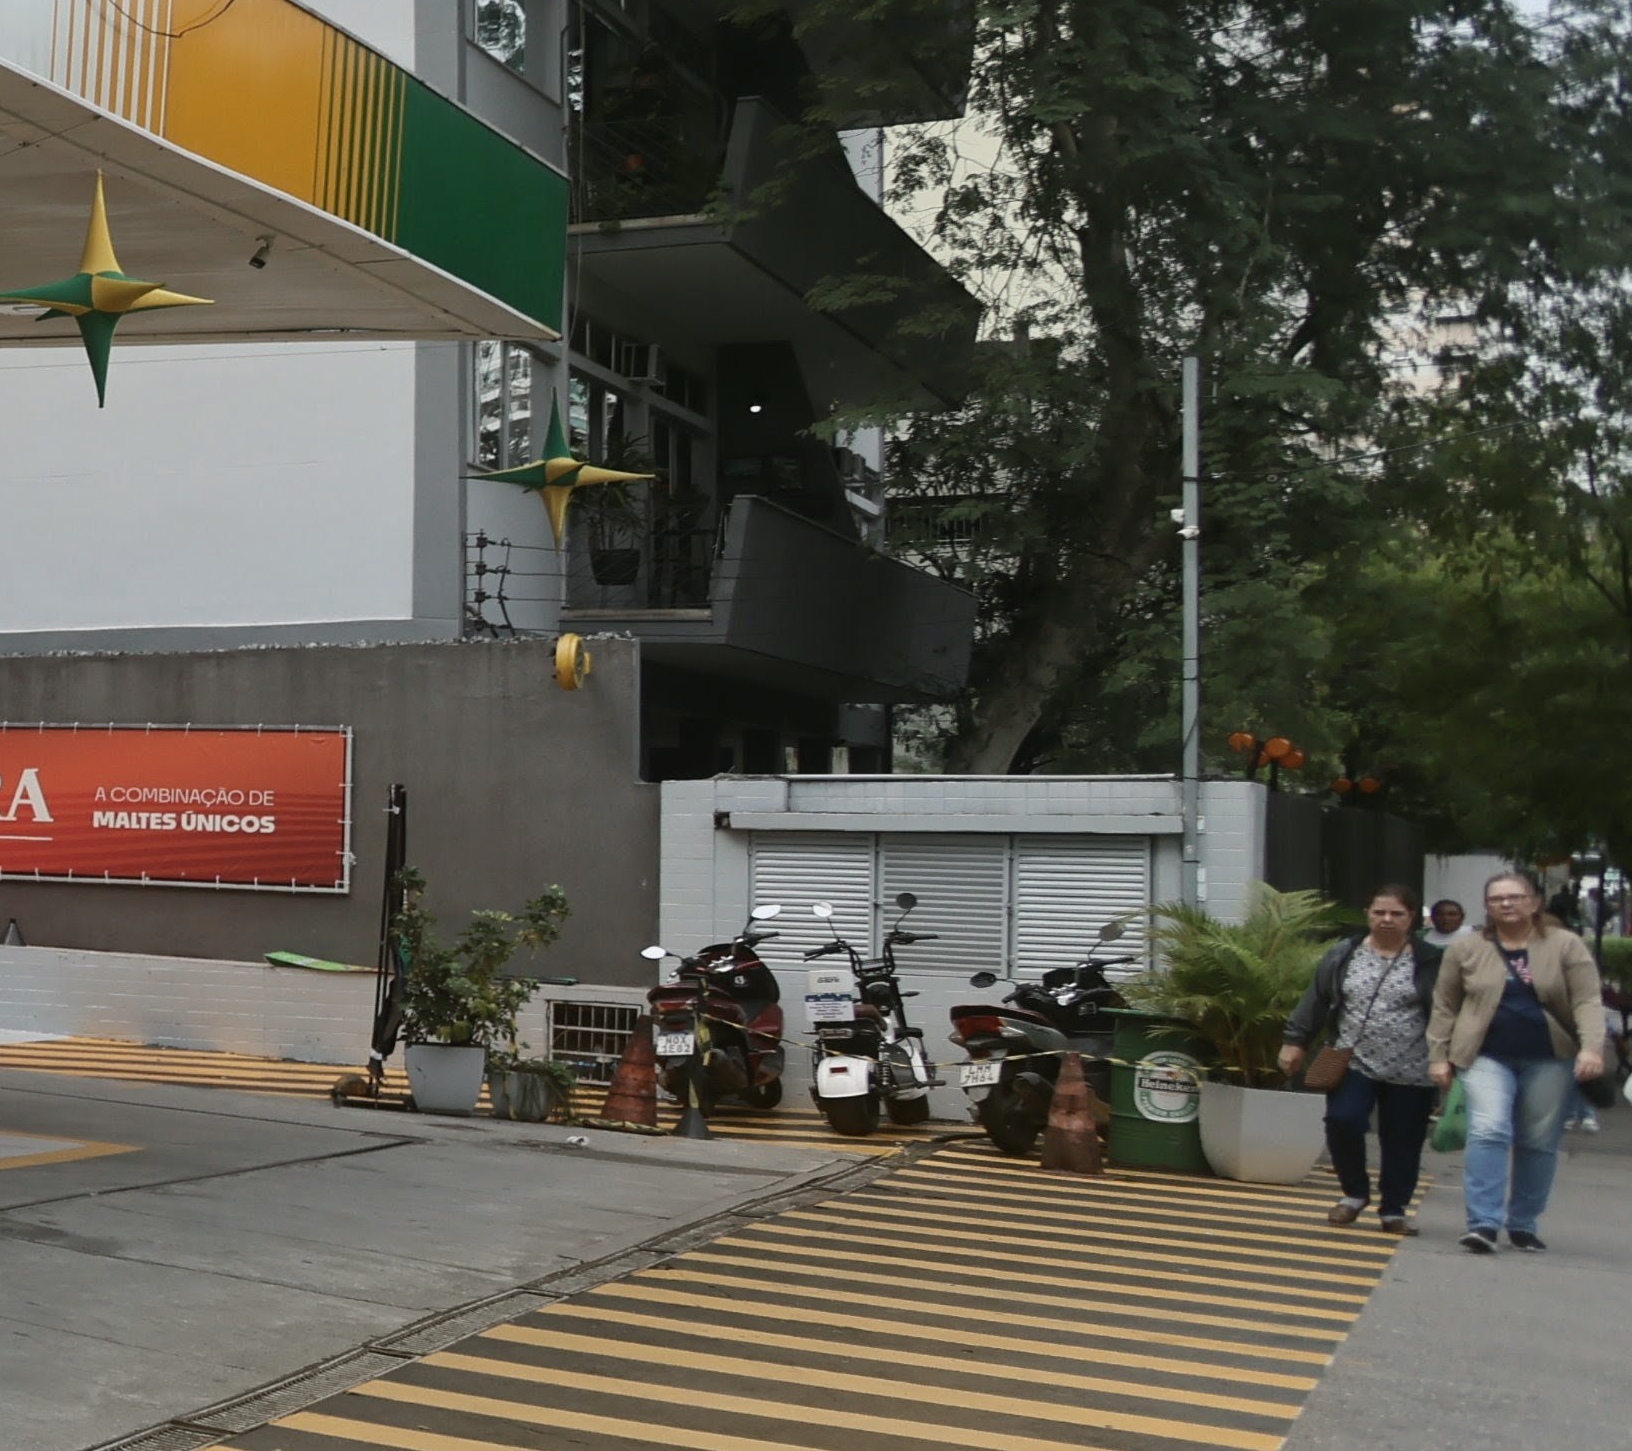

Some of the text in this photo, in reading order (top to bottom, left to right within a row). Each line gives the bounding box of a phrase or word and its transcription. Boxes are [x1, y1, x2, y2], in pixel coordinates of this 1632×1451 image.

[94, 787, 274, 808] A COMBINAÇÃO DE
[93, 809, 275, 833] MALTES ÚNICOS
